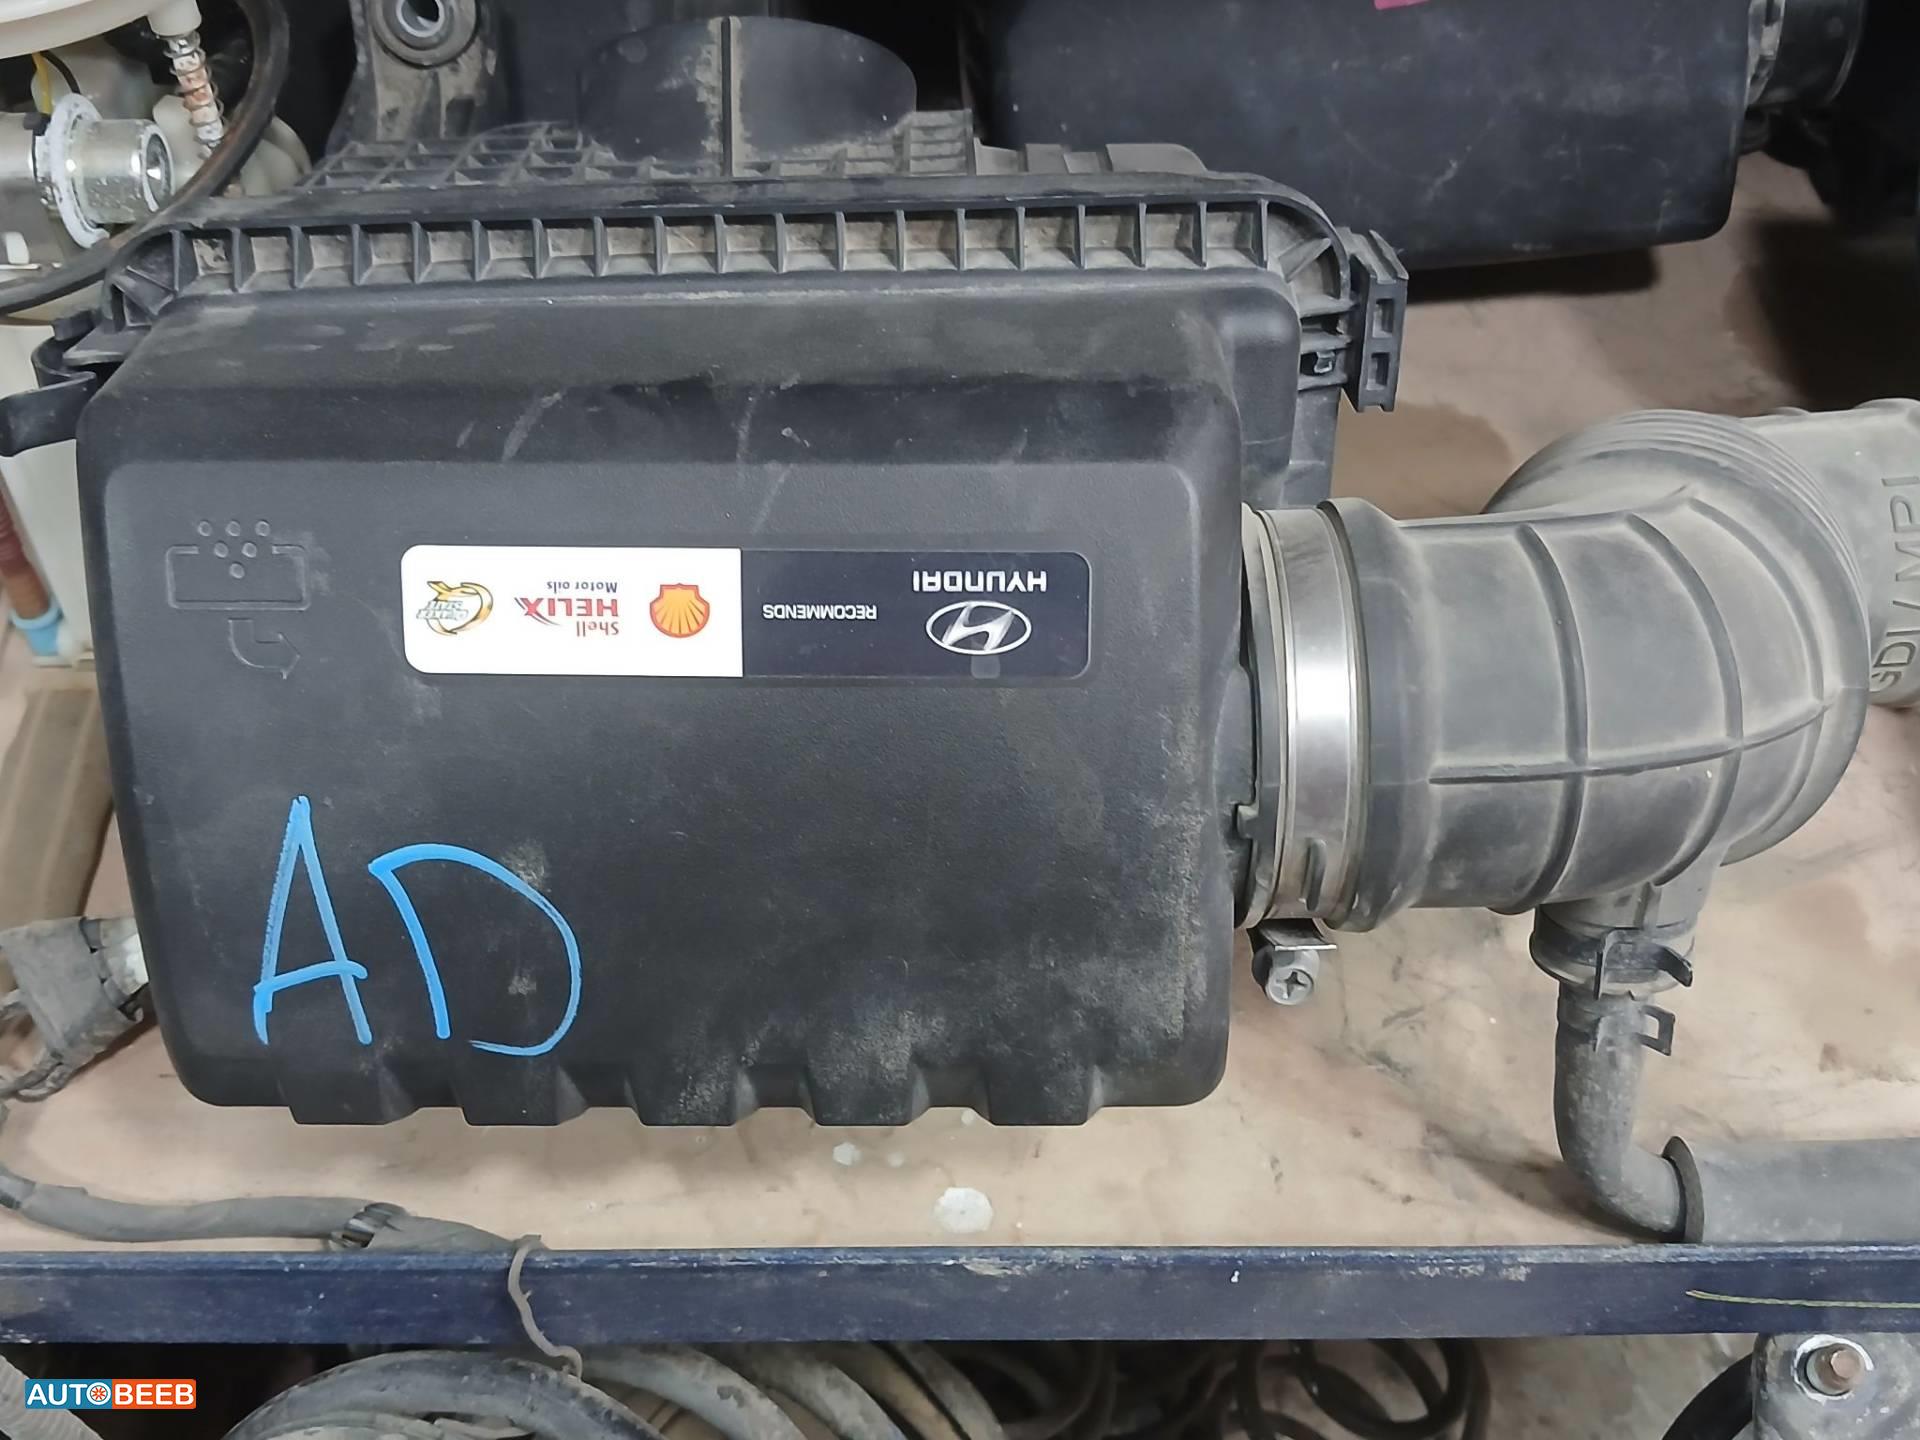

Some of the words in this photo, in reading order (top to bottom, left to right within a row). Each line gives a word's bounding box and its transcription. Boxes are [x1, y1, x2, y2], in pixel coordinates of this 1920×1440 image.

[546, 580, 570, 594] oils
[575, 581, 619, 594] Motor
[911, 570, 1047, 592] HYUNDAI
[517, 596, 619, 618] HELIX
[762, 603, 878, 620] RECOMMENDS
[573, 621, 620, 637] Shell
[253, 795, 582, 1056] AD
